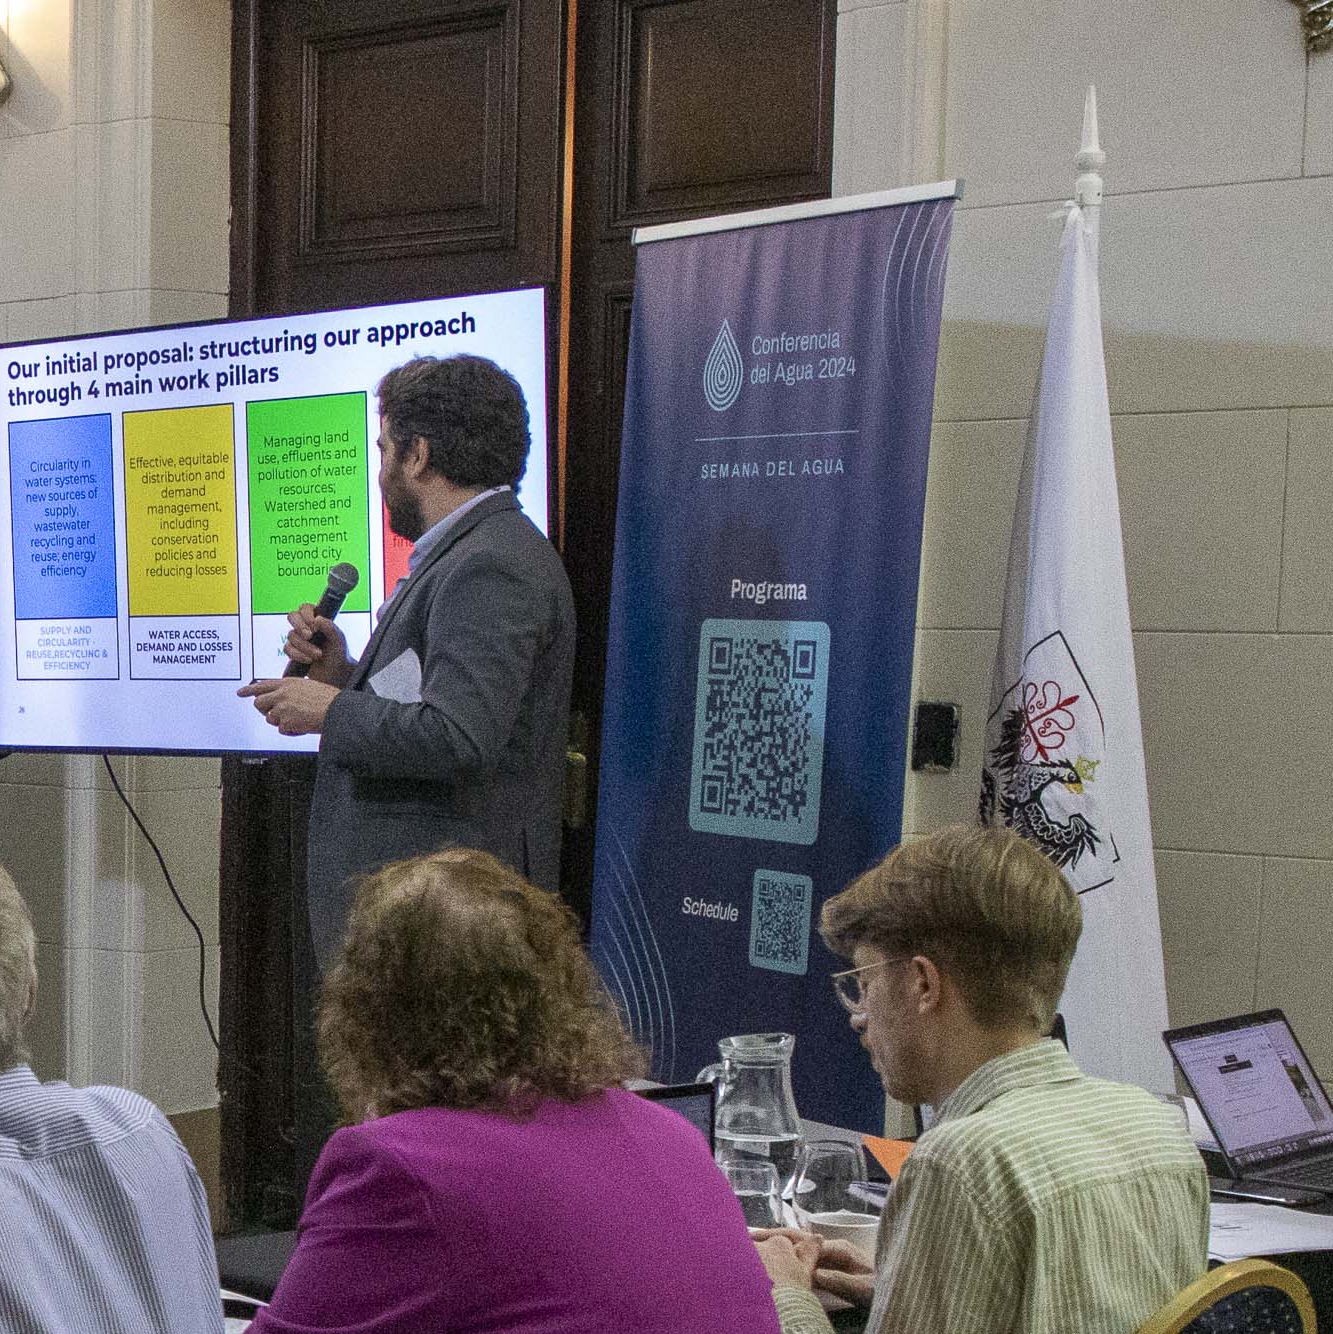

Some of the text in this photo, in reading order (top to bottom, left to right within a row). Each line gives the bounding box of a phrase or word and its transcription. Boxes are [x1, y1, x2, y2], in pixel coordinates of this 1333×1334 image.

[7, 312, 476, 379] Our initial proposal: structuring our approach
[752, 329, 840, 355] Conferencia
[750, 356, 856, 386] del Agua 2024
[8, 364, 279, 406] through 4 main work pillars
[264, 430, 349, 449] Managing land
[129, 452, 229, 470] Effective, equitable
[257, 446, 357, 465] use, effluents and
[30, 457, 91, 472] Circularity in
[701, 458, 845, 480] SEMANA DEL AGUA
[141, 468, 225, 484] distribution and
[258, 465, 357, 483] pollution of water
[25, 477, 52, 488] water
[26, 487, 99, 503] new sources of
[161, 485, 206, 499] demand
[147, 501, 222, 516] management,
[264, 496, 351, 512] Watershed and
[34, 520, 91, 532] wastewater
[160, 518, 209, 531] including
[277, 515, 340, 528] catchment
[30, 533, 96, 549] recycling and
[151, 533, 219, 546] conservation
[270, 531, 348, 546] management
[61, 550, 96, 563] energy
[155, 547, 217, 564] policies and
[277, 547, 342, 562] beyond city
[40, 565, 87, 578] efficiency
[145, 565, 227, 579] reducing losses
[278, 565, 332, 577] boundari
[731, 579, 808, 604] Programa
[40, 625, 92, 635] SUPPLY AND
[148, 630, 220, 640] WATER ACCESS,
[37, 638, 91, 647] CIRCULARITY
[136, 642, 233, 652] DEMAND AND LOSSES
[43, 661, 91, 671] EFFICIENCY
[152, 654, 216, 664] MANAGEMENT
[682, 896, 739, 922] Schedule
